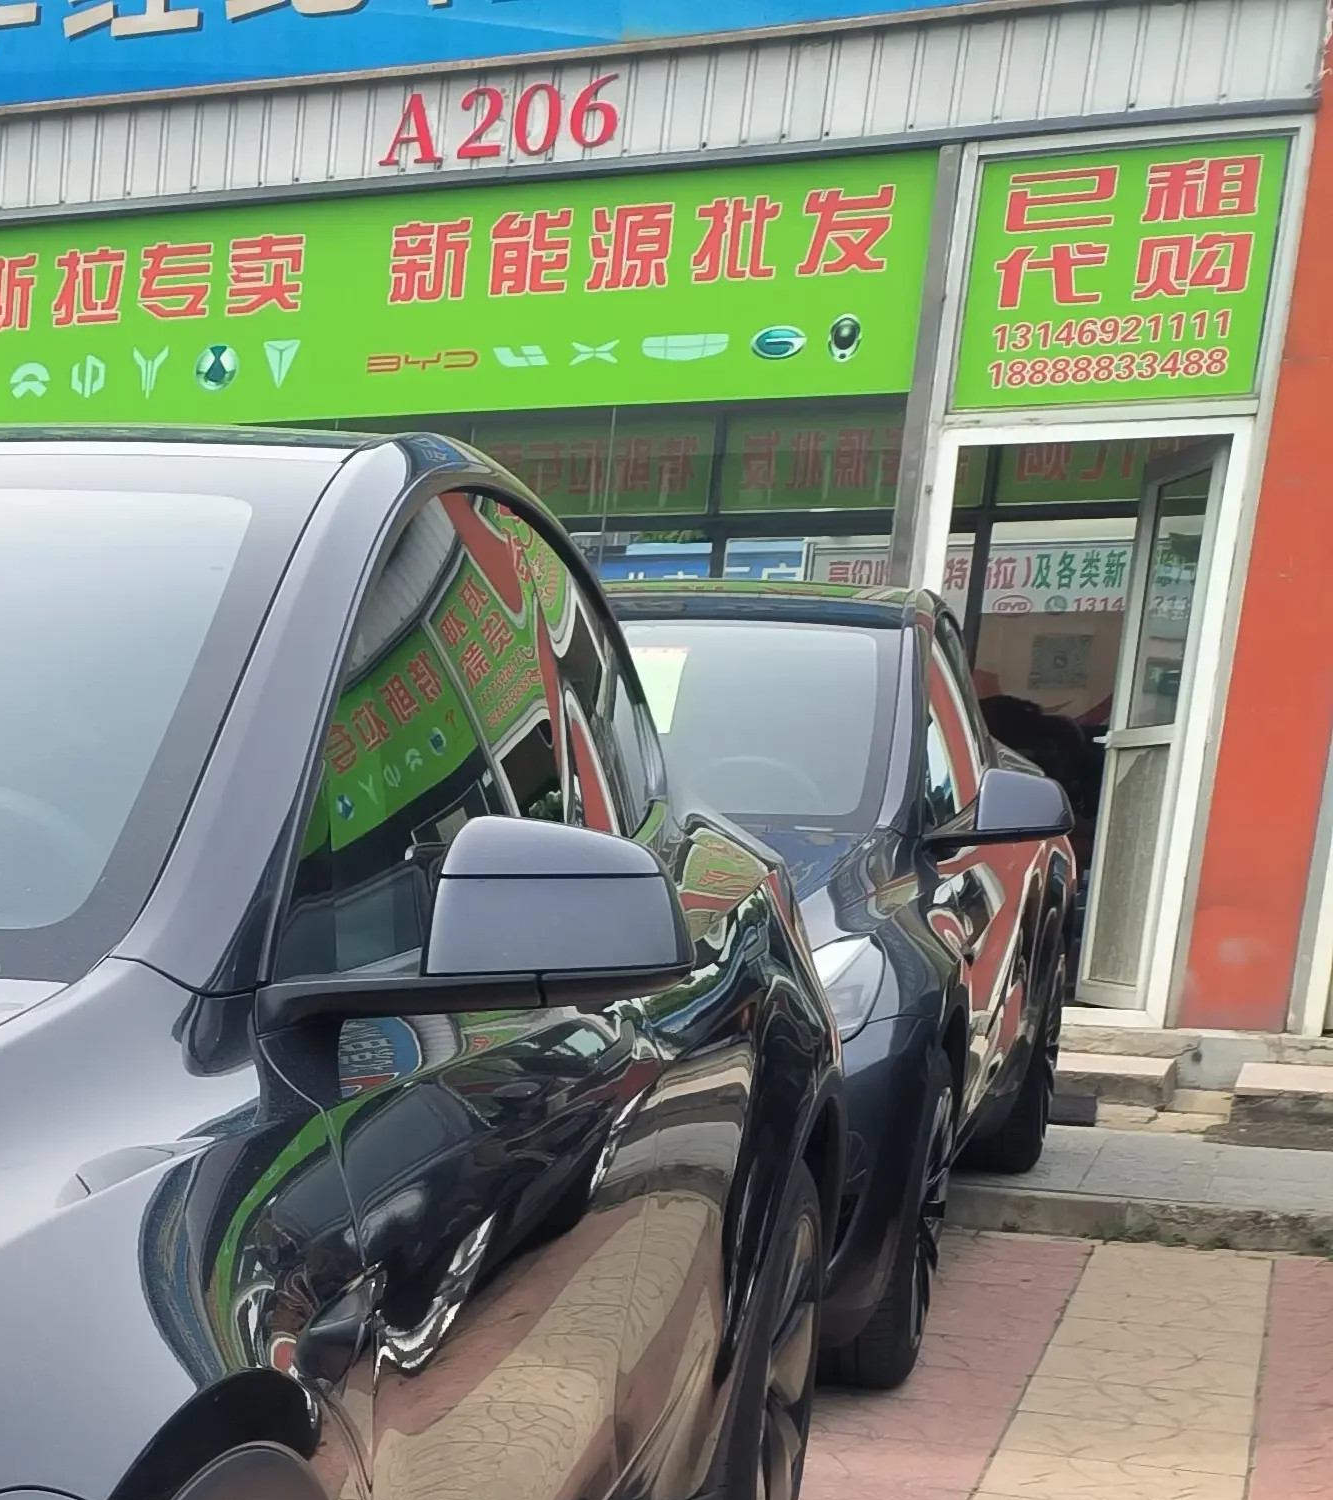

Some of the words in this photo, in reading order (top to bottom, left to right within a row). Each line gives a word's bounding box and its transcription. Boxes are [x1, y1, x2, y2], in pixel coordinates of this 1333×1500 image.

[378, 72, 621, 168] A206
[388, 184, 898, 305] 新能源批发
[994, 232, 1255, 310] 代购
[992, 309, 1233, 352] 13146921111
[365, 348, 479, 375] BYD
[988, 347, 1230, 389] 18888833488
